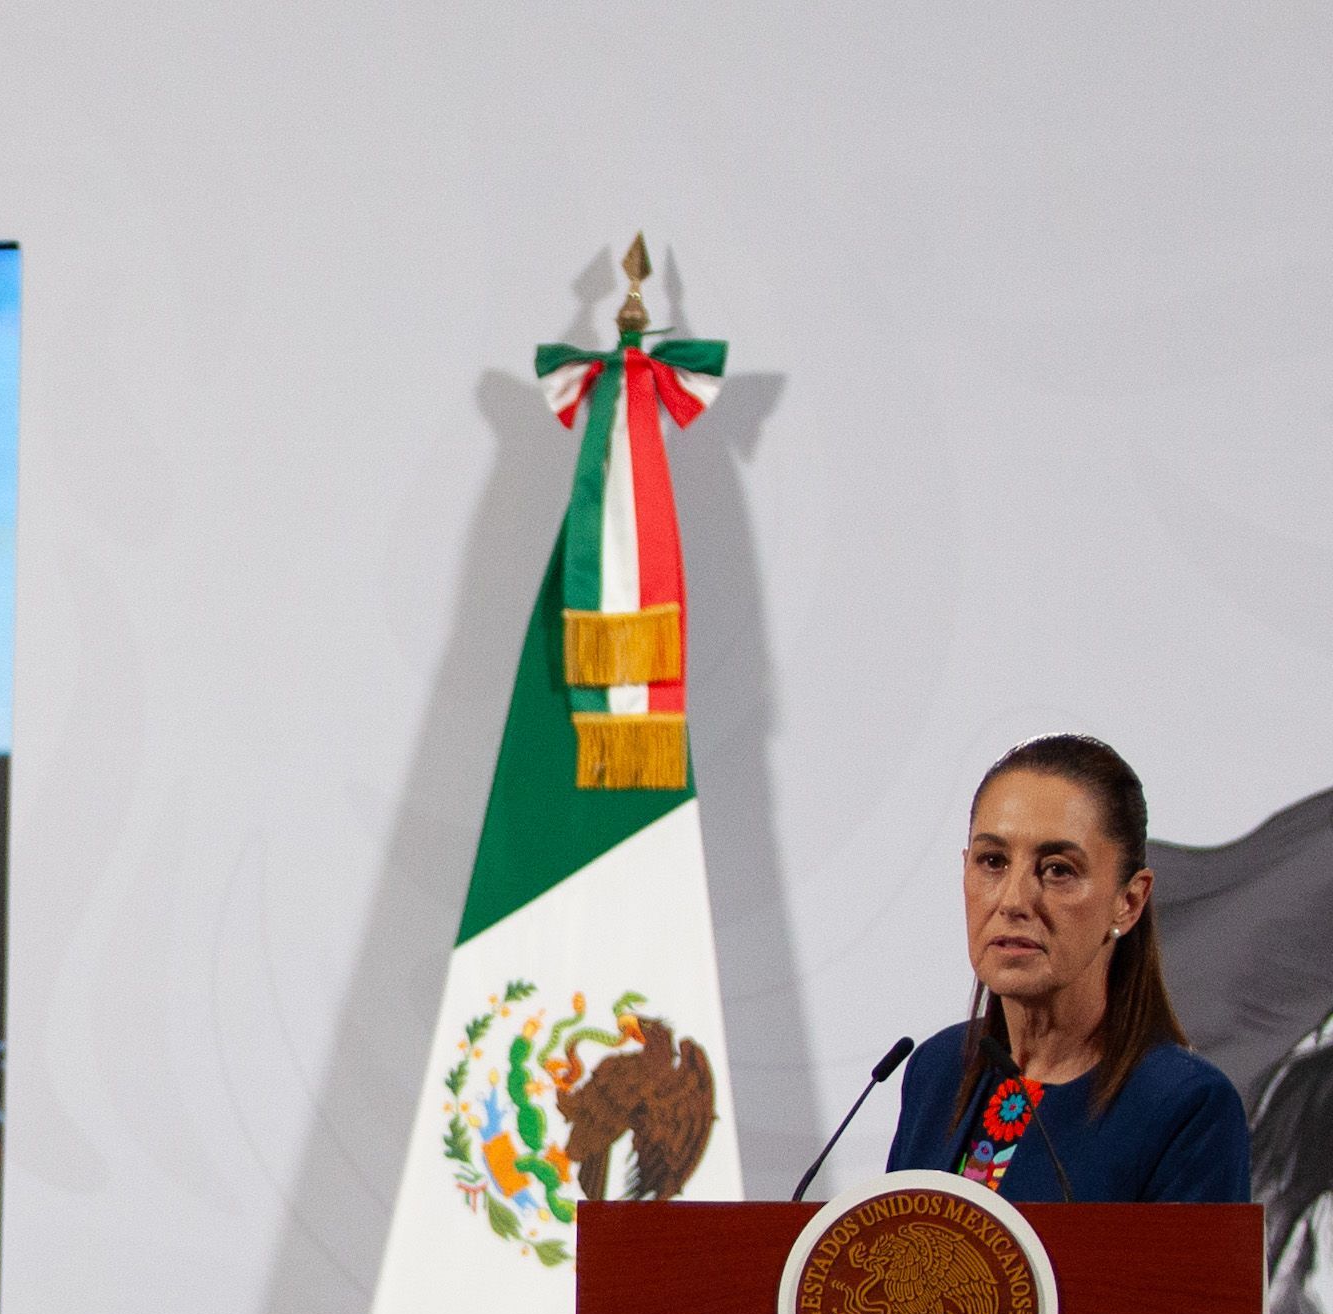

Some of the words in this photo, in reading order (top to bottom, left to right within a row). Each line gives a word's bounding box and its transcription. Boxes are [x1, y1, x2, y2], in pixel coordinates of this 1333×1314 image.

[801, 1216, 860, 1310] ESTADOS
[859, 1194, 943, 1227] UNIDOS
[945, 1198, 1034, 1310] MEXICANOS
